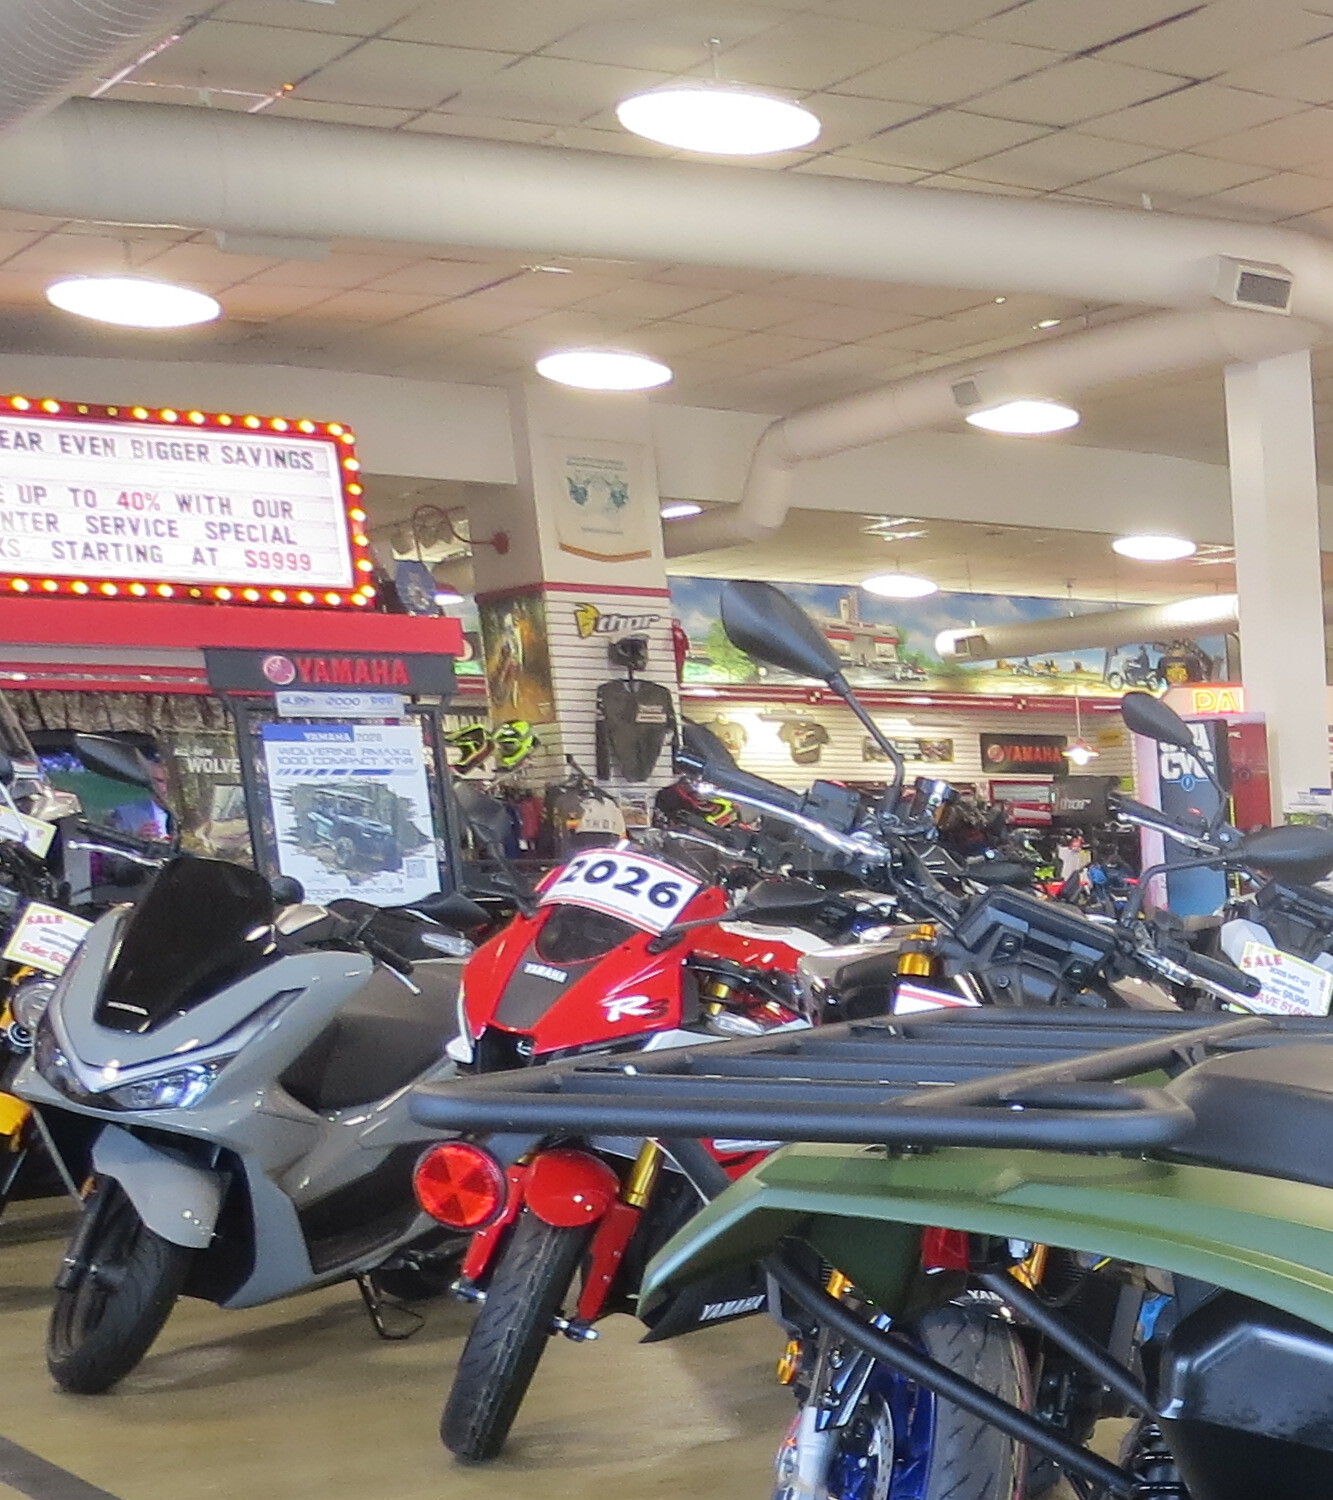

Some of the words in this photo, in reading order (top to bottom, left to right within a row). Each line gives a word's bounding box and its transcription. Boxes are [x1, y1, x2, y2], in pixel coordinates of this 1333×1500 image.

[59, 433, 117, 457] EVEN
[131, 440, 211, 464] BIGGER
[221, 446, 315, 471] SAVINGS
[18, 485, 47, 505] UP
[68, 487, 97, 509] TO
[117, 491, 161, 512] 40%
[175, 494, 233, 517] WITH
[253, 499, 295, 520] OUR
[86, 515, 180, 539] SERVICE
[205, 520, 298, 546] SPECIAL
[52, 540, 164, 564] STARTING
[192, 547, 219, 567] AT
[296, 658, 411, 685] YAMAHA
[1006, 745, 1063, 763] YAMAHA
[557, 859, 683, 910] 2026
[523, 962, 568, 984] YAMAHA
[1243, 953, 1283, 969] SALE
